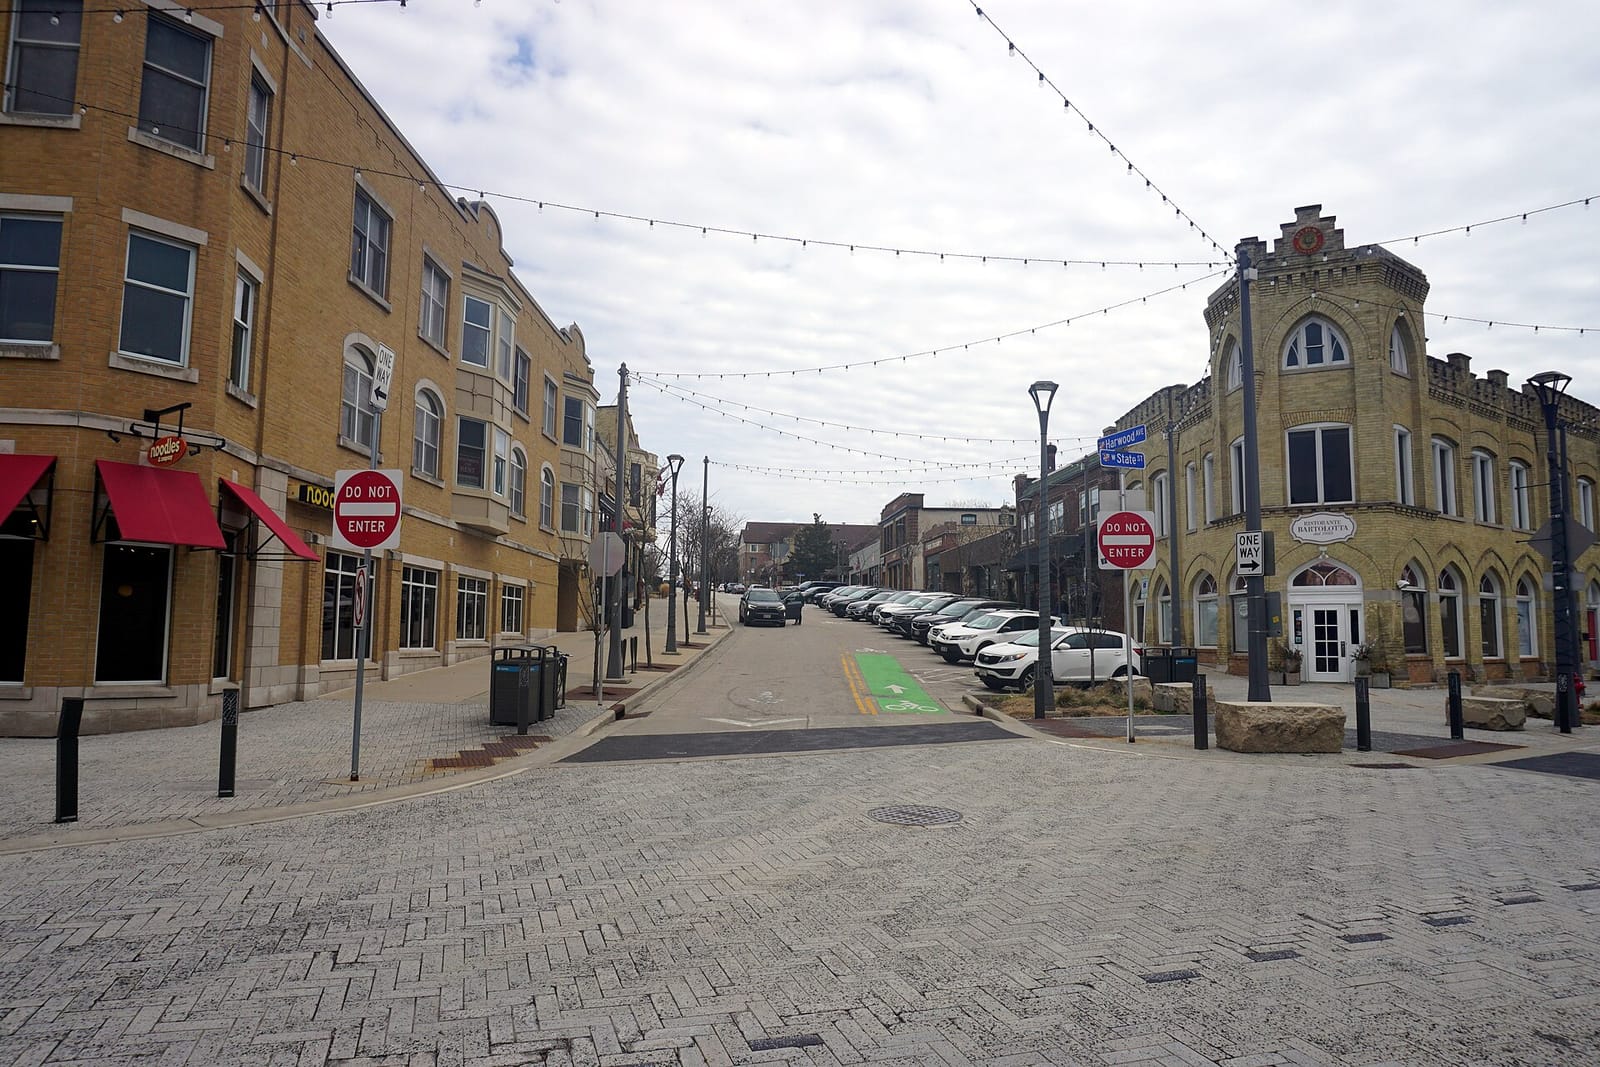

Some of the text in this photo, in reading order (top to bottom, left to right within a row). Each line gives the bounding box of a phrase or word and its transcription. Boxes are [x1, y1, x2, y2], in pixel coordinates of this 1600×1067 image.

[379, 350, 393, 369] ONE
[376, 367, 391, 385] WAY
[1105, 427, 1145, 450] Harwood AVE
[150, 437, 180, 458] noodles
[1116, 453, 1137, 465] State
[345, 486, 392, 498] DO NOT
[348, 520, 385, 532] ENTER
[1106, 523, 1146, 532] DO NOT
[1239, 535, 1259, 546] ONE
[1108, 548, 1145, 558] ENTER
[1240, 547, 1260, 558] WAY
